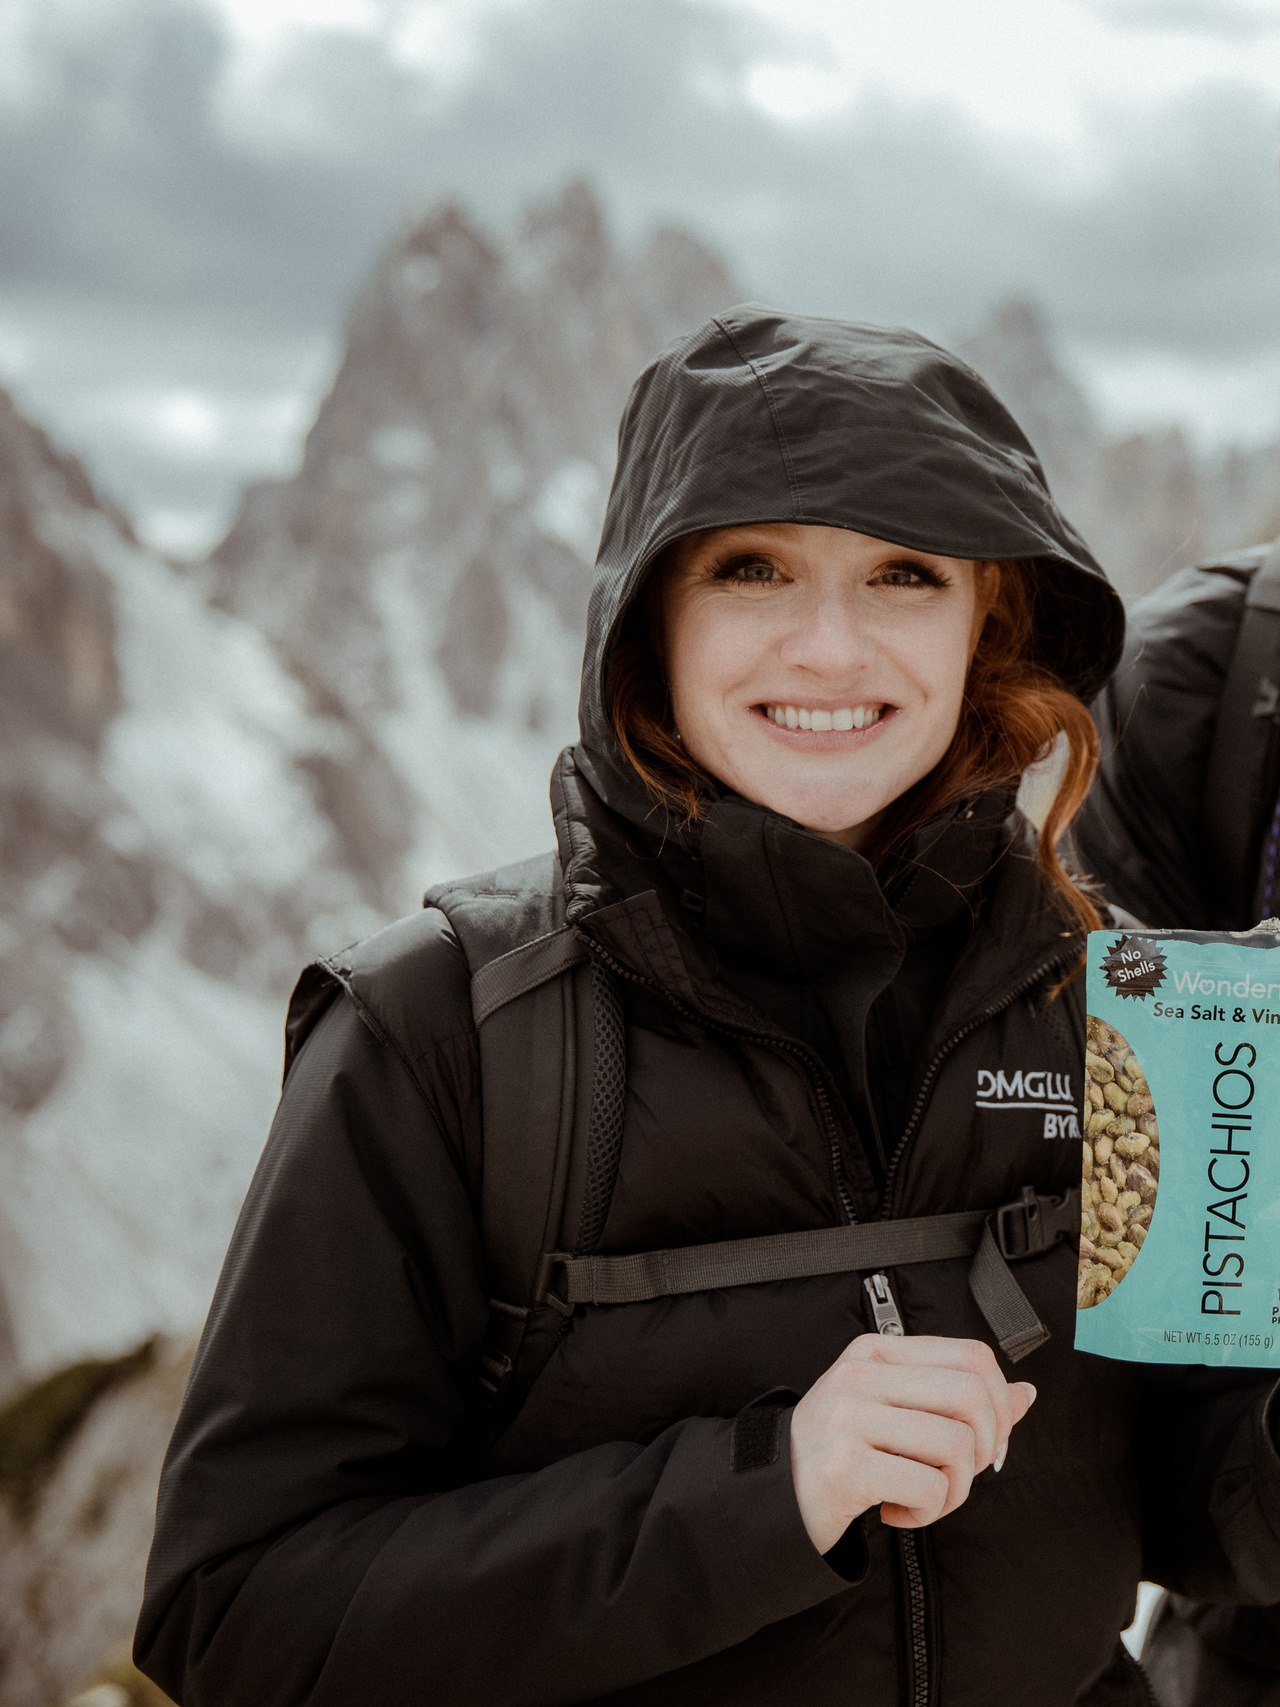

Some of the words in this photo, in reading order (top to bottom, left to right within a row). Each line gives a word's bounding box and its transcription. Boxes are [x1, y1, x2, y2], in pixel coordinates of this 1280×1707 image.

[1120, 949, 1142, 964] No
[1116, 961, 1156, 983] Shells
[1153, 1002, 1184, 1019] Sea
[1190, 1005, 1226, 1022] Salt
[1232, 1008, 1246, 1023] &
[1200, 1041, 1257, 1316] PISTACHIOS
[1163, 1330, 1183, 1344] NET
[1185, 1332, 1202, 1344] WT
[1204, 1333, 1220, 1346] 5.5
[1223, 1334, 1236, 1346] OZ
[1239, 1334, 1261, 1348] (155
[1263, 1335, 1275, 1349] g)
